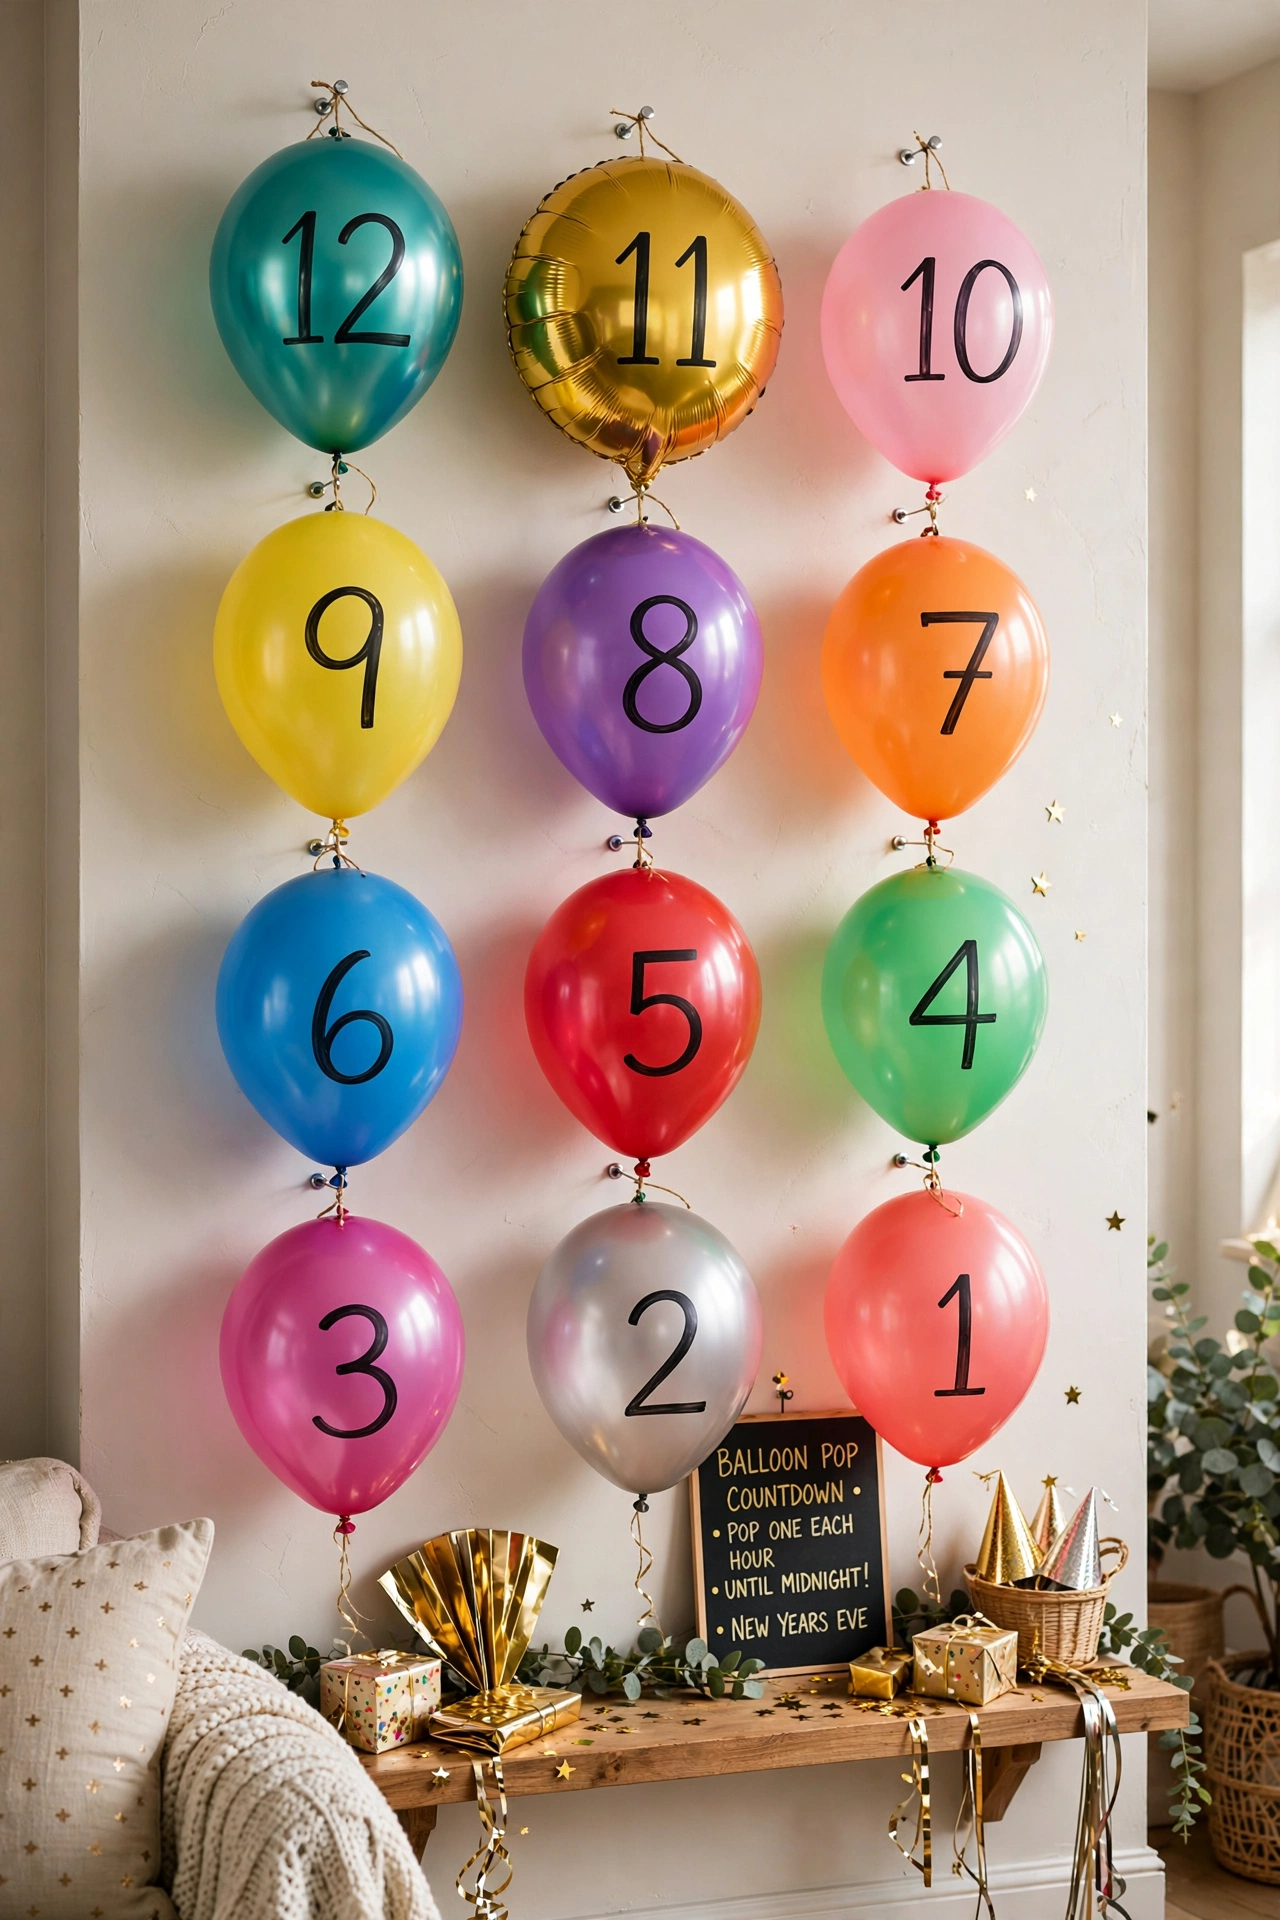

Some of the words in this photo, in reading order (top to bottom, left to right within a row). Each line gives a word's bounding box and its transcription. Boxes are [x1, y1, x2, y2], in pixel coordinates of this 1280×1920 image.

[282, 210, 411, 346] 12
[615, 231, 717, 368] 11
[901, 256, 1023, 383] 10
[305, 587, 383, 728] 9
[622, 595, 702, 734] 8
[921, 612, 997, 734] 7
[312, 950, 393, 1084] 6
[624, 950, 702, 1076] 5
[909, 940, 996, 1069] 4
[312, 1304, 397, 1438] 3
[625, 1290, 706, 1416] 2
[935, 1275, 985, 1396] 1
[717, 1446, 808, 1477] BALLOON
[822, 1443, 858, 1468] POP
[727, 1480, 843, 1511] COUNTDOWN
[725, 1576, 773, 1599] UNTIL
[782, 1562, 868, 1593] MIDNIGHT!
[728, 1522, 759, 1543] POP
[769, 1519, 802, 1540] ONE
[811, 1514, 853, 1536] EACH
[730, 1548, 775, 1570] HOUR
[732, 1615, 768, 1641] NEW
[777, 1612, 828, 1637] YEARS
[837, 1608, 867, 1630] EVE
